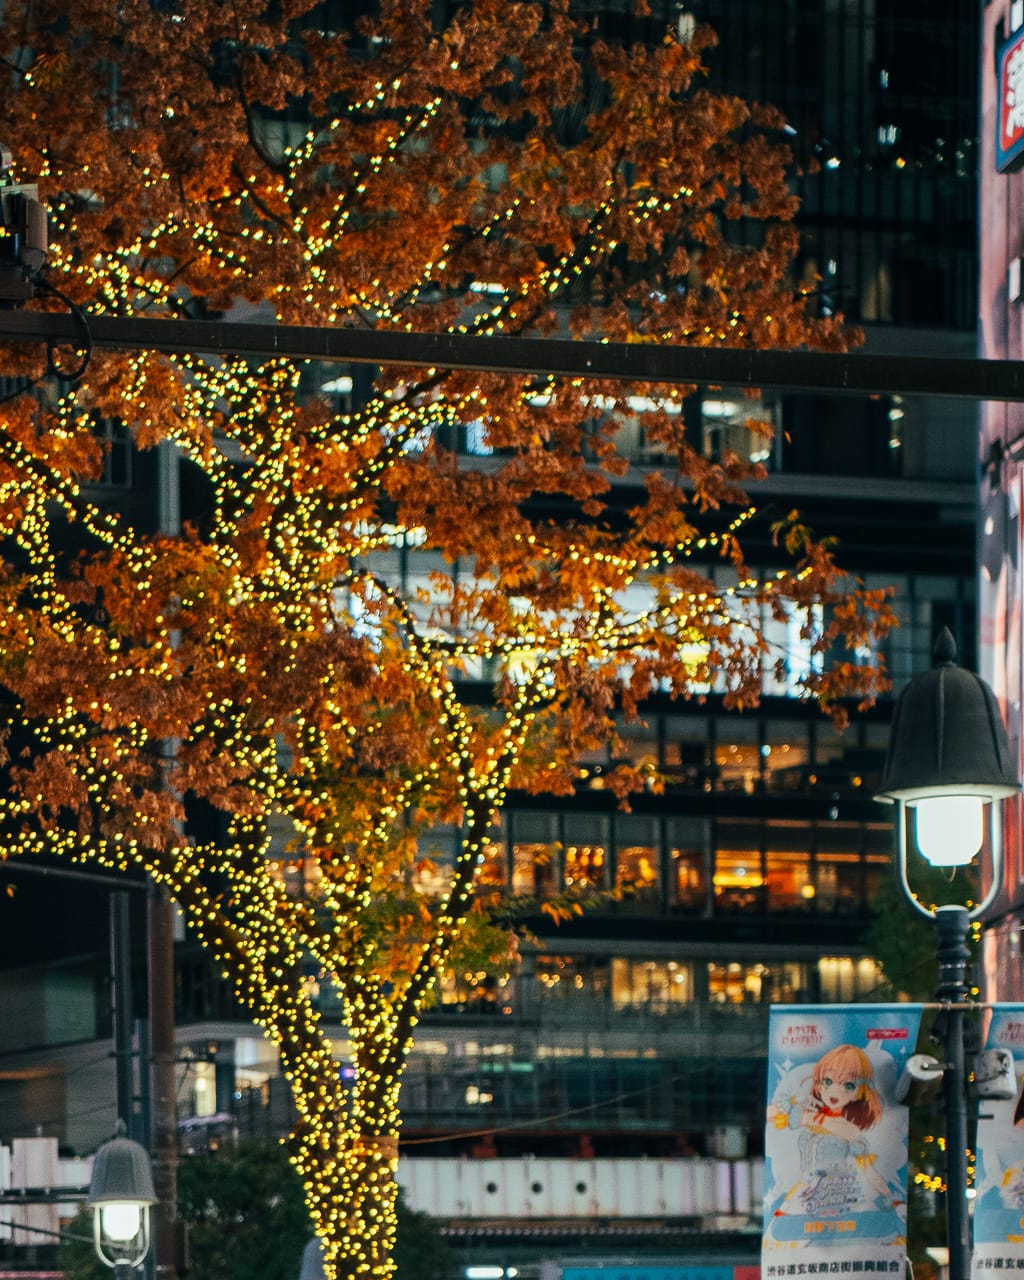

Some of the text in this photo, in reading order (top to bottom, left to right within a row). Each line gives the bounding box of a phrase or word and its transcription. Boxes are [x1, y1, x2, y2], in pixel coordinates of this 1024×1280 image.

[767, 1260, 900, 1277] 渋谷道玄坂商店街振興組合
